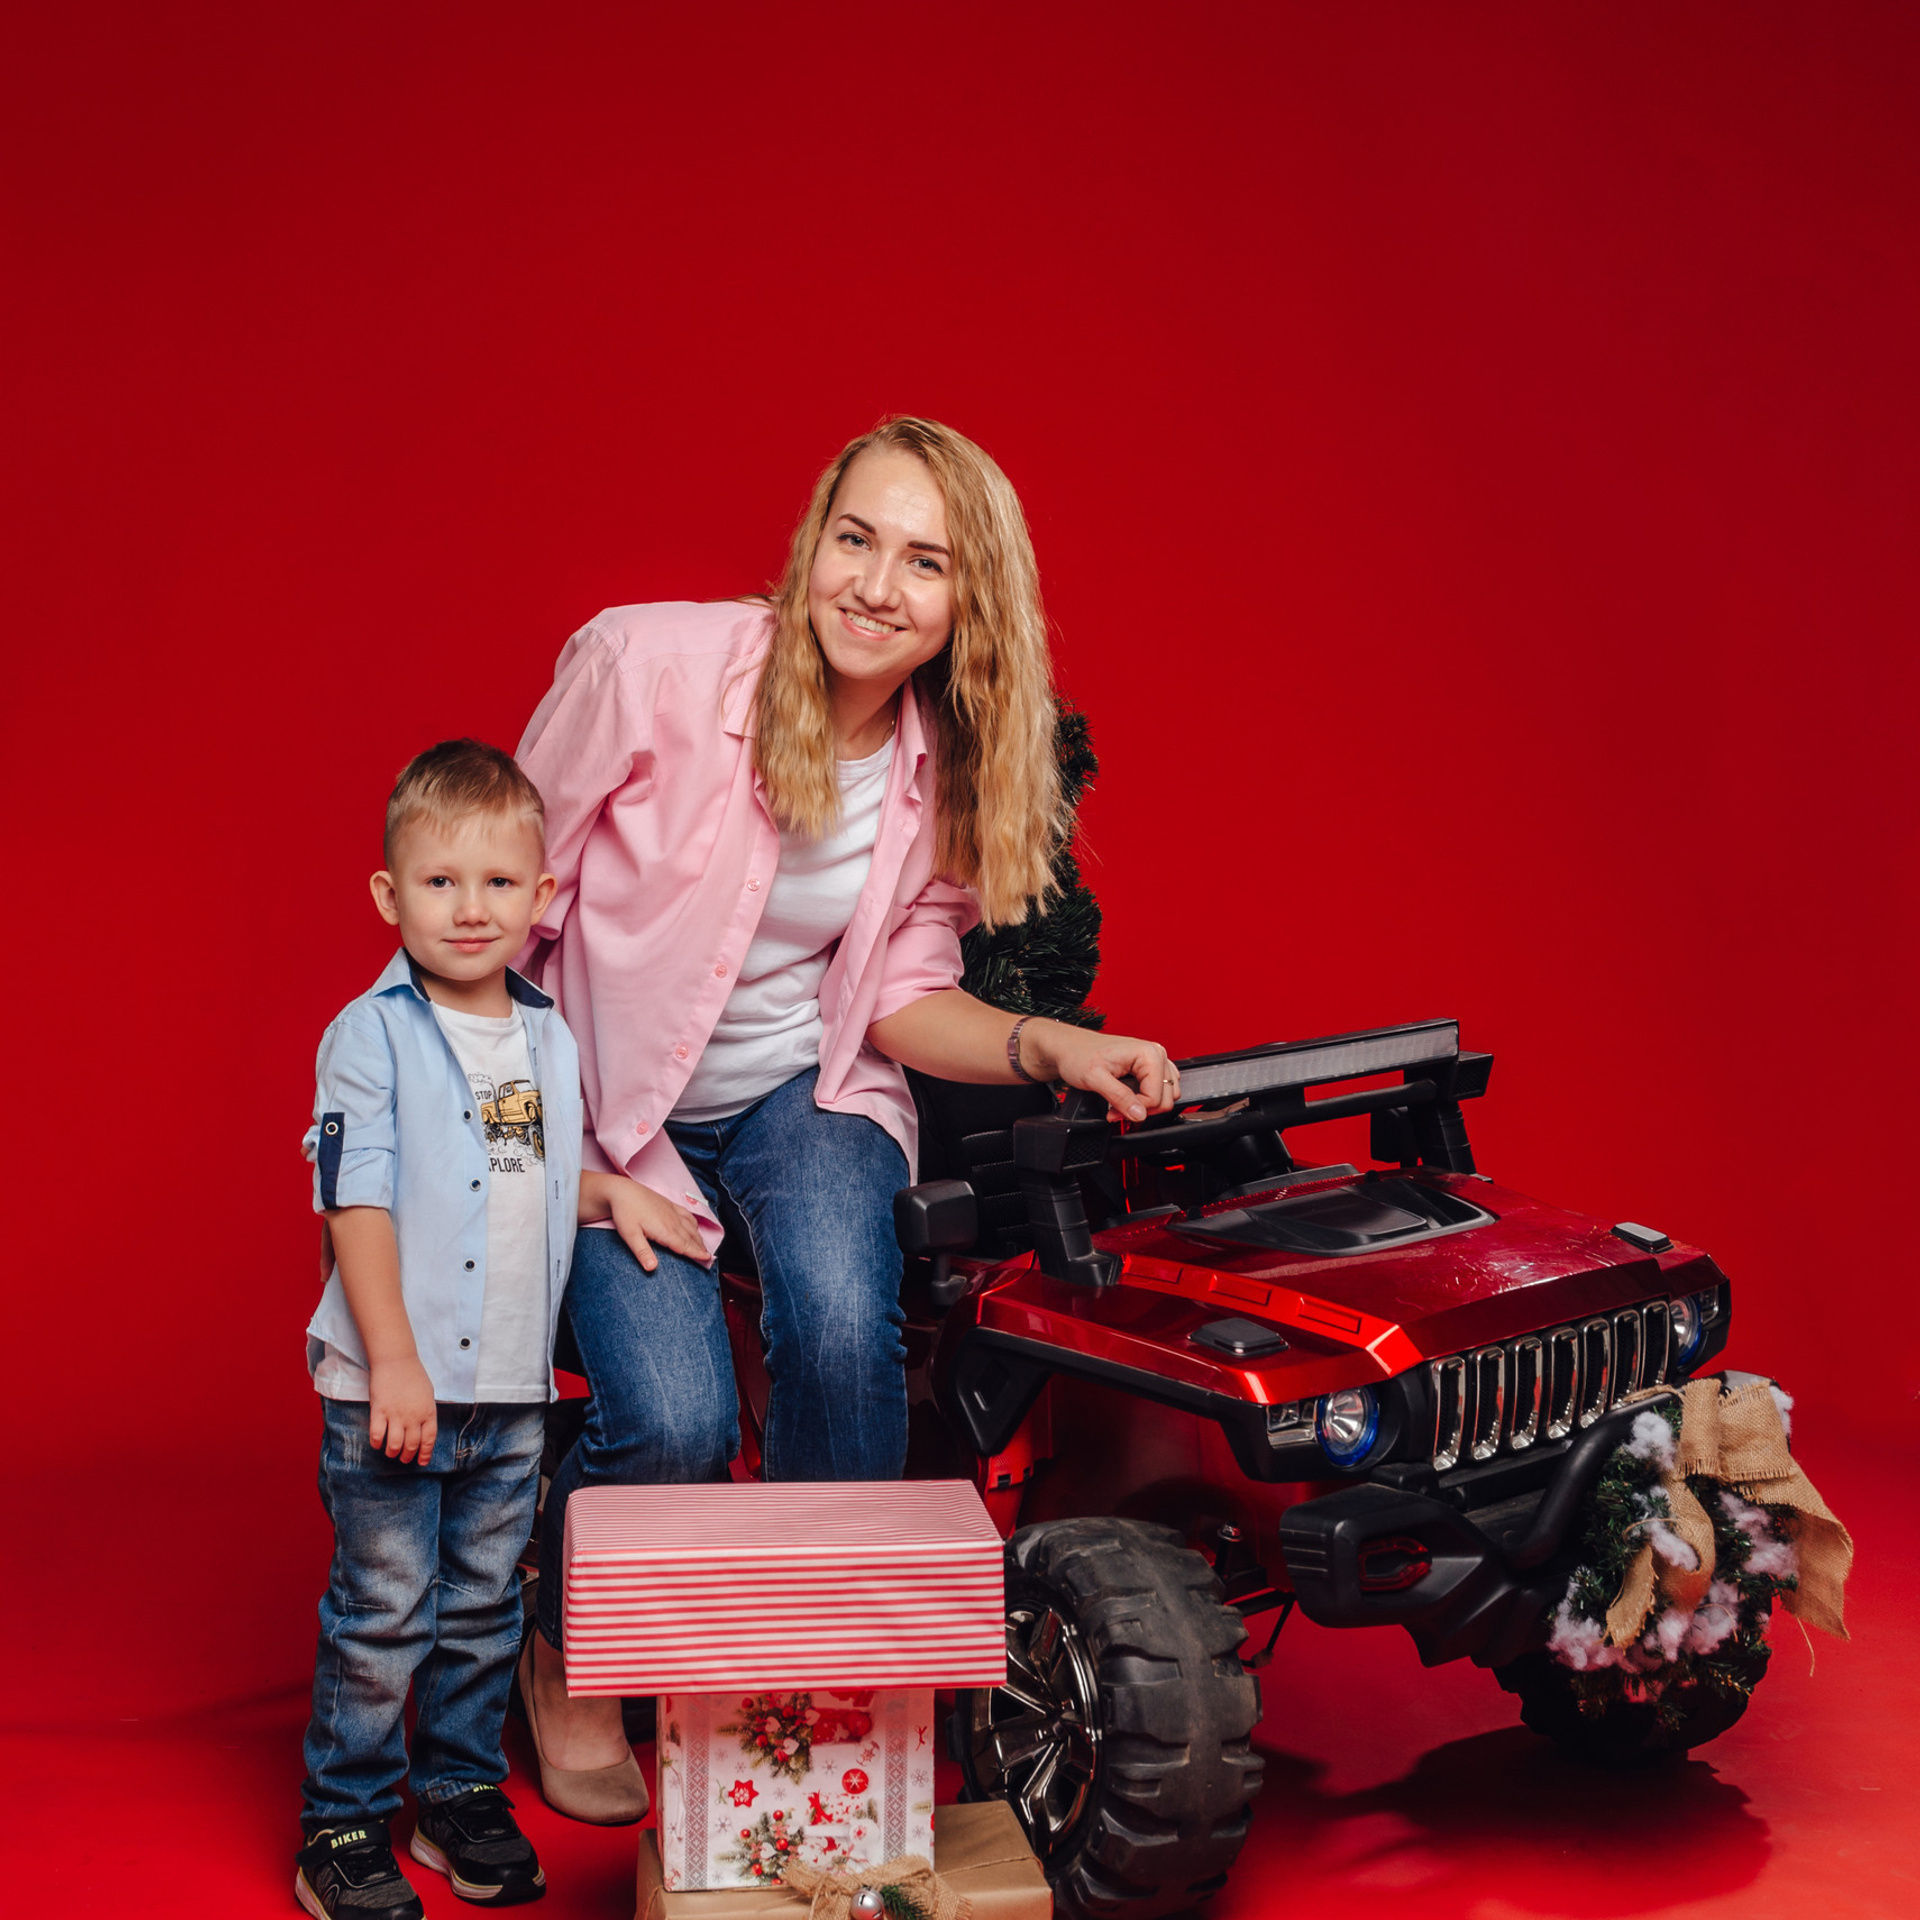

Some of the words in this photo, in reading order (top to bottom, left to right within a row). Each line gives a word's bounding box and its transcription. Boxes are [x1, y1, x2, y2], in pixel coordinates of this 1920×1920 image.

[475, 1090, 493, 1100] STOP
[489, 1157, 525, 1173] PLORE
[331, 1830, 367, 1849] BIKER
